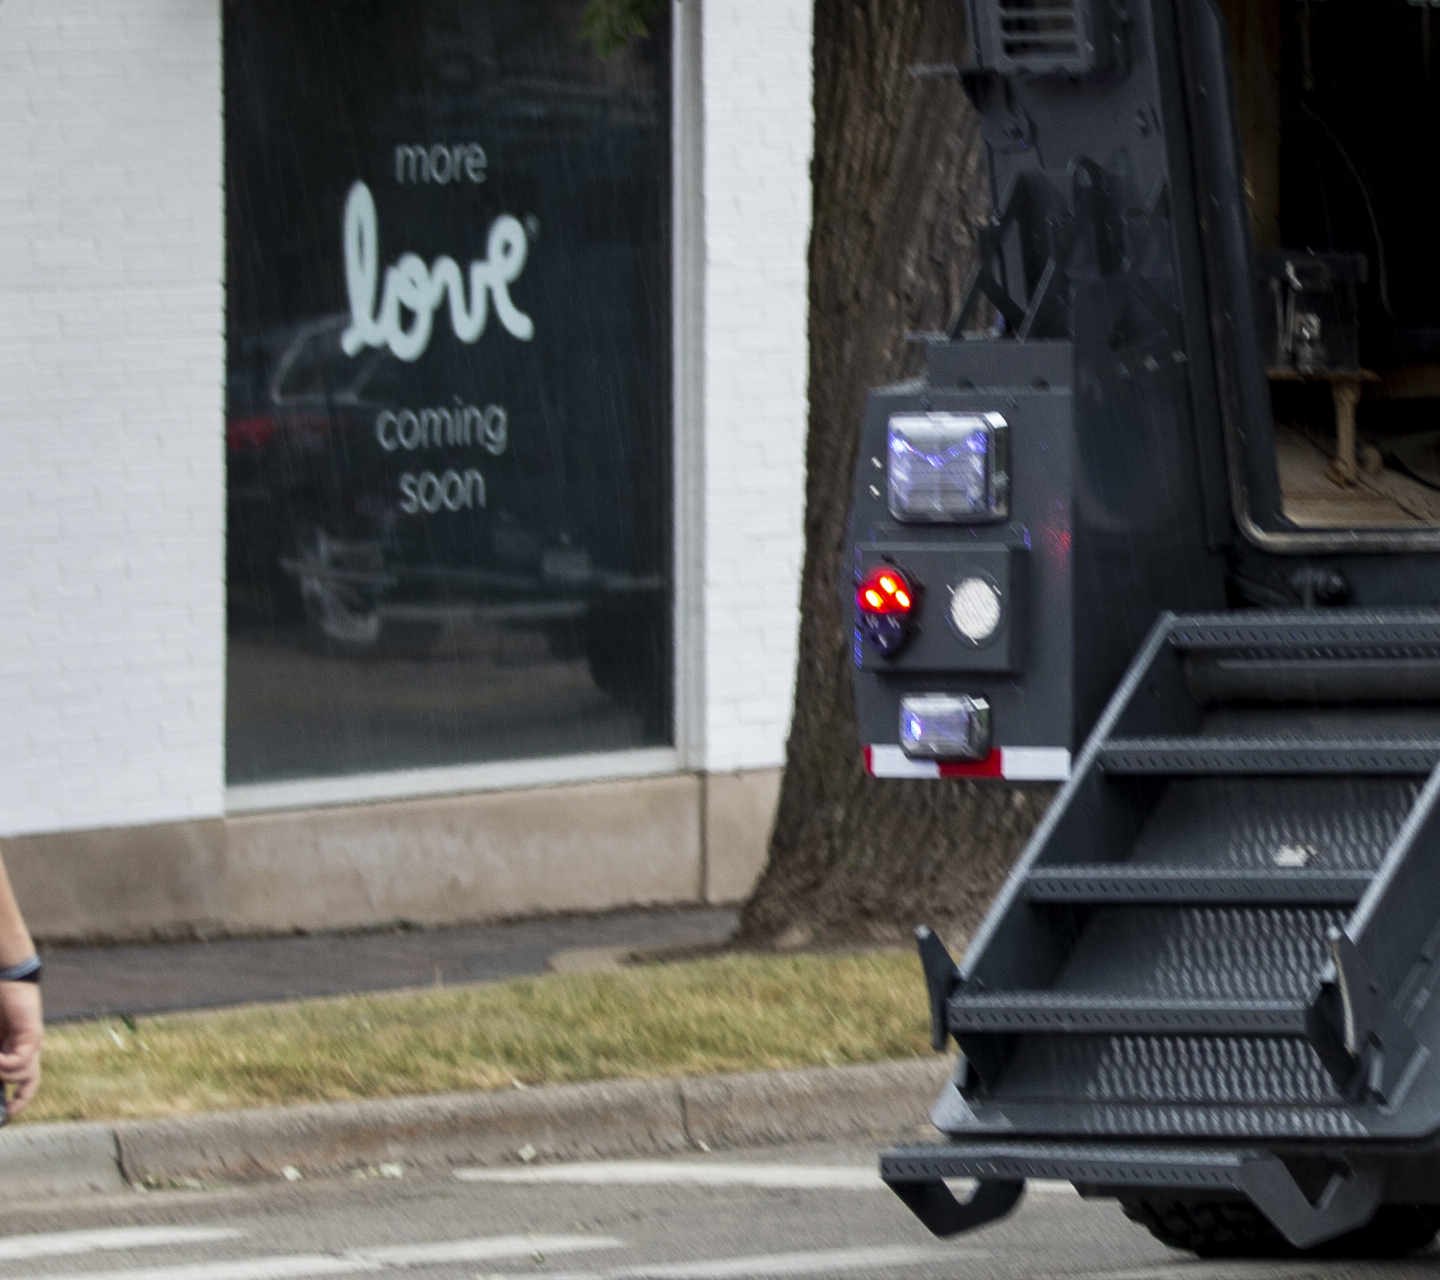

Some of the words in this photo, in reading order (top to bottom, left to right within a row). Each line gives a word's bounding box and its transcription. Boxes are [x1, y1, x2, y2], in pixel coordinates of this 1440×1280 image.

[394, 143, 488, 185] more
[341, 178, 535, 362] love
[376, 396, 508, 455] coming
[398, 469, 486, 514] soon
